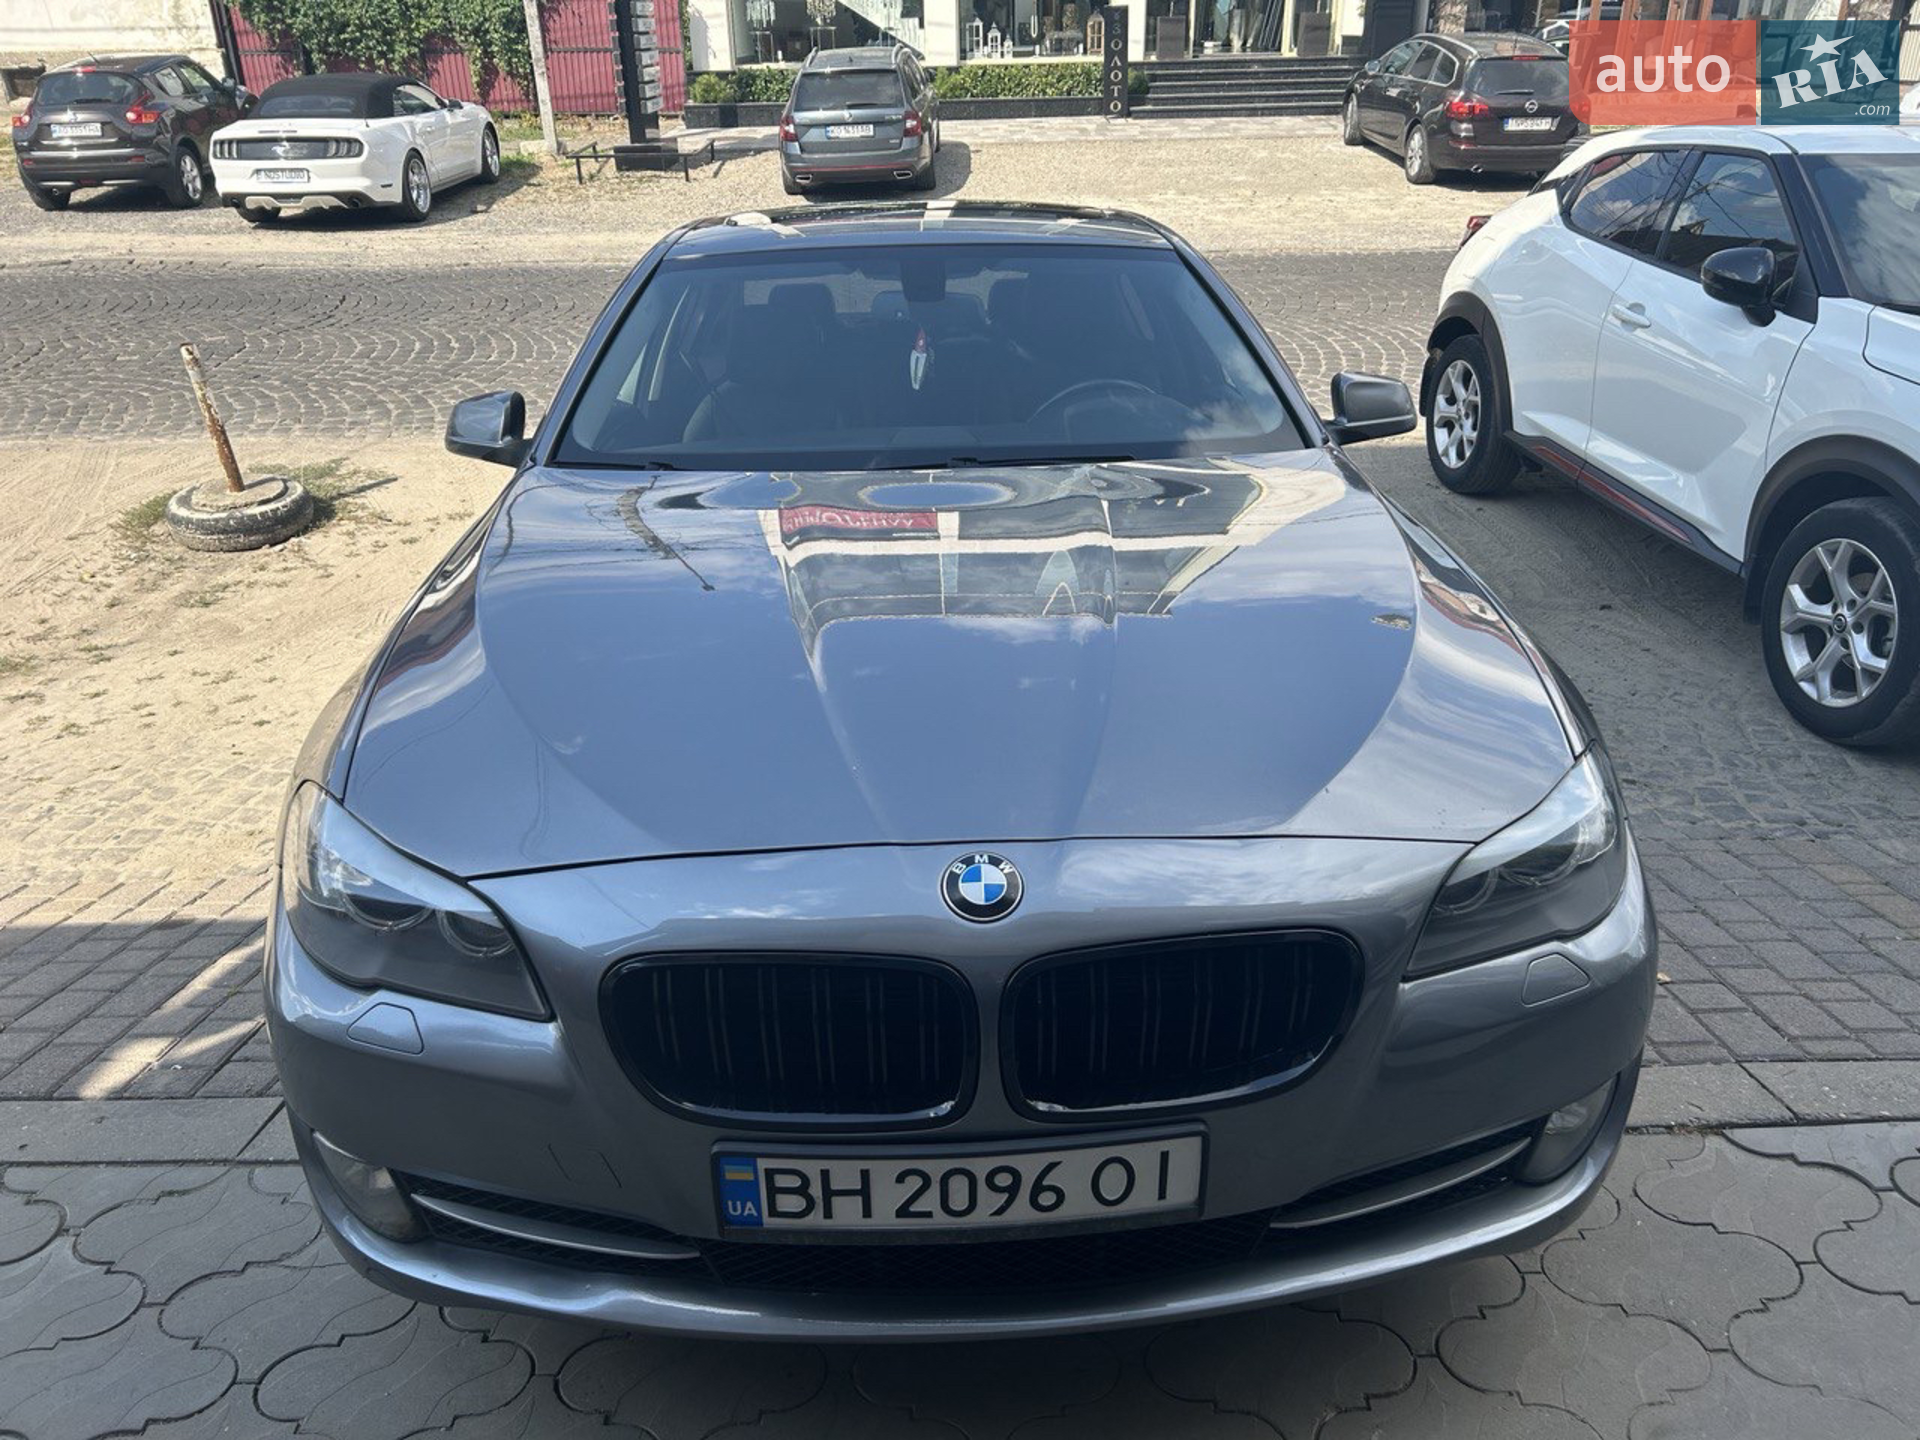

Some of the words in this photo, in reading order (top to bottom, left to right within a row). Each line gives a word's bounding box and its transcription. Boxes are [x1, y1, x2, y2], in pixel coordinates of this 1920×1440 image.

[952, 854, 1014, 875] BMW
[764, 1168, 873, 1220] BH
[895, 1160, 1066, 1219] 2096
[728, 1200, 758, 1217] UA
